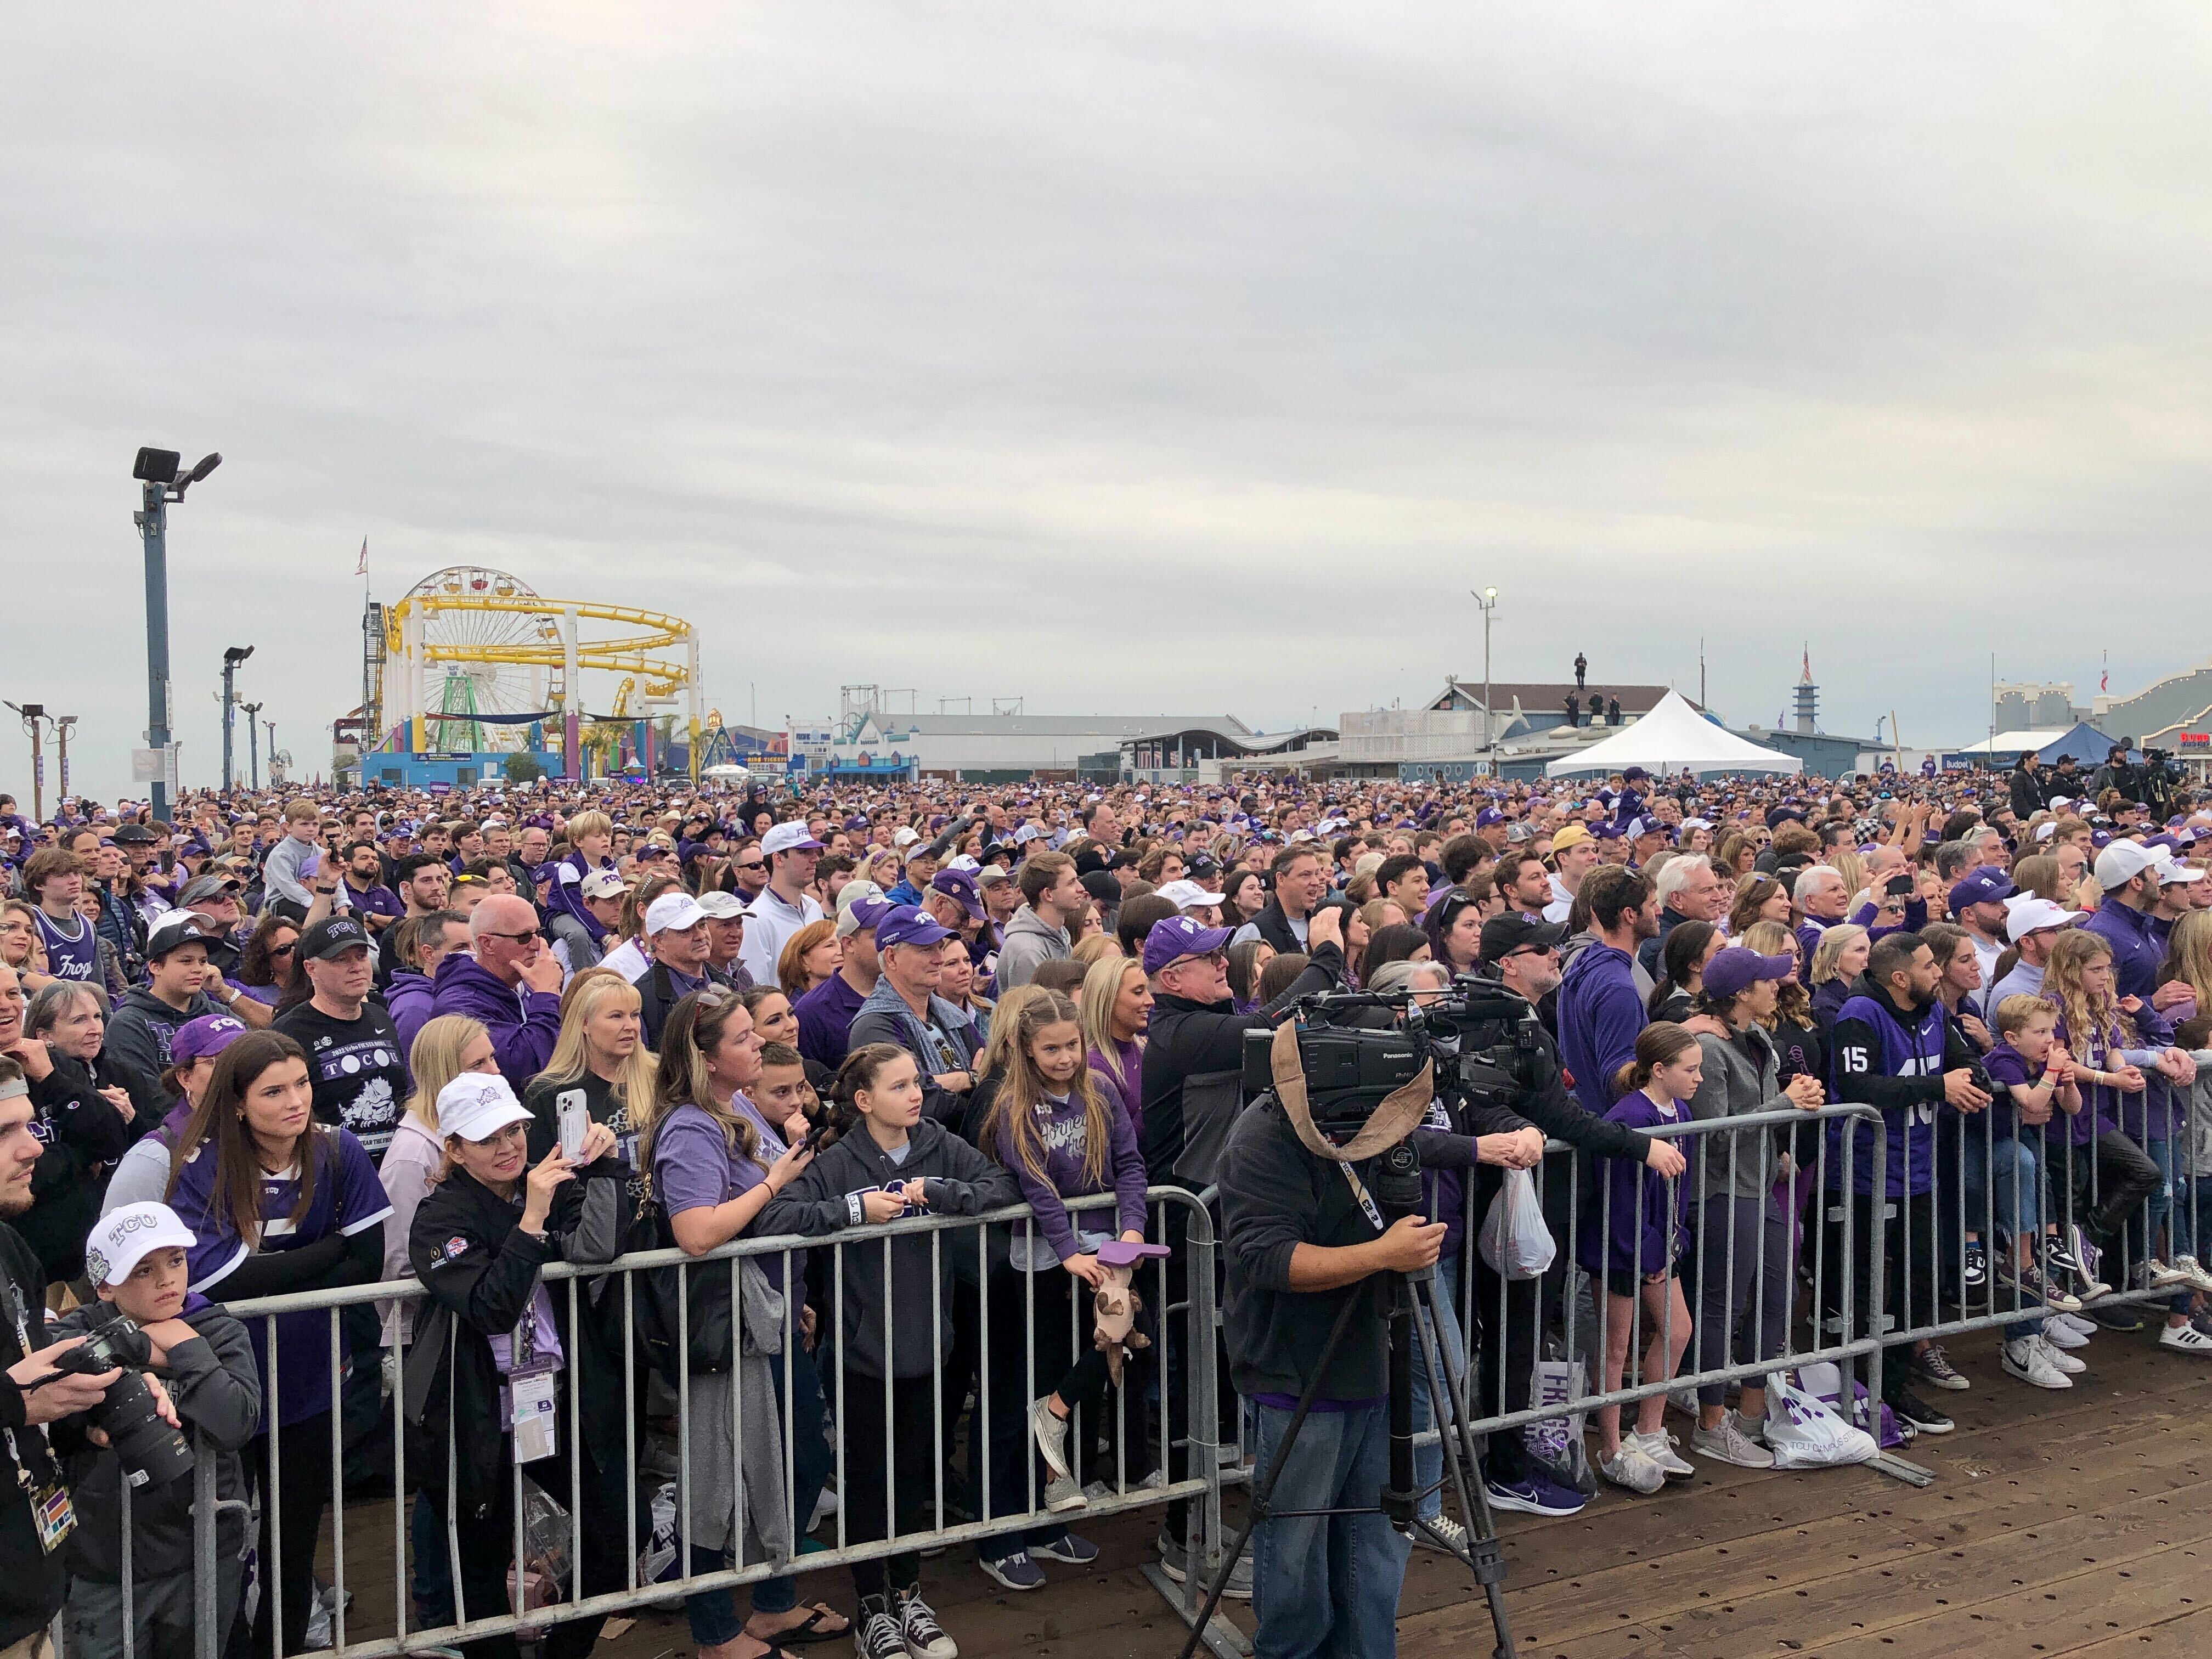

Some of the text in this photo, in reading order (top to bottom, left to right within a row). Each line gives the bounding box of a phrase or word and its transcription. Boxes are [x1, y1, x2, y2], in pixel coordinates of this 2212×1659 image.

[327, 922, 358, 939] TCU
[1842, 1046, 1868, 1073] 15
[264, 1187, 279, 1195] TCU
[109, 1214, 158, 1248] TCU
[1790, 1441, 1810, 1452] TCU
[1813, 1438, 1843, 1453] CAMPUS
